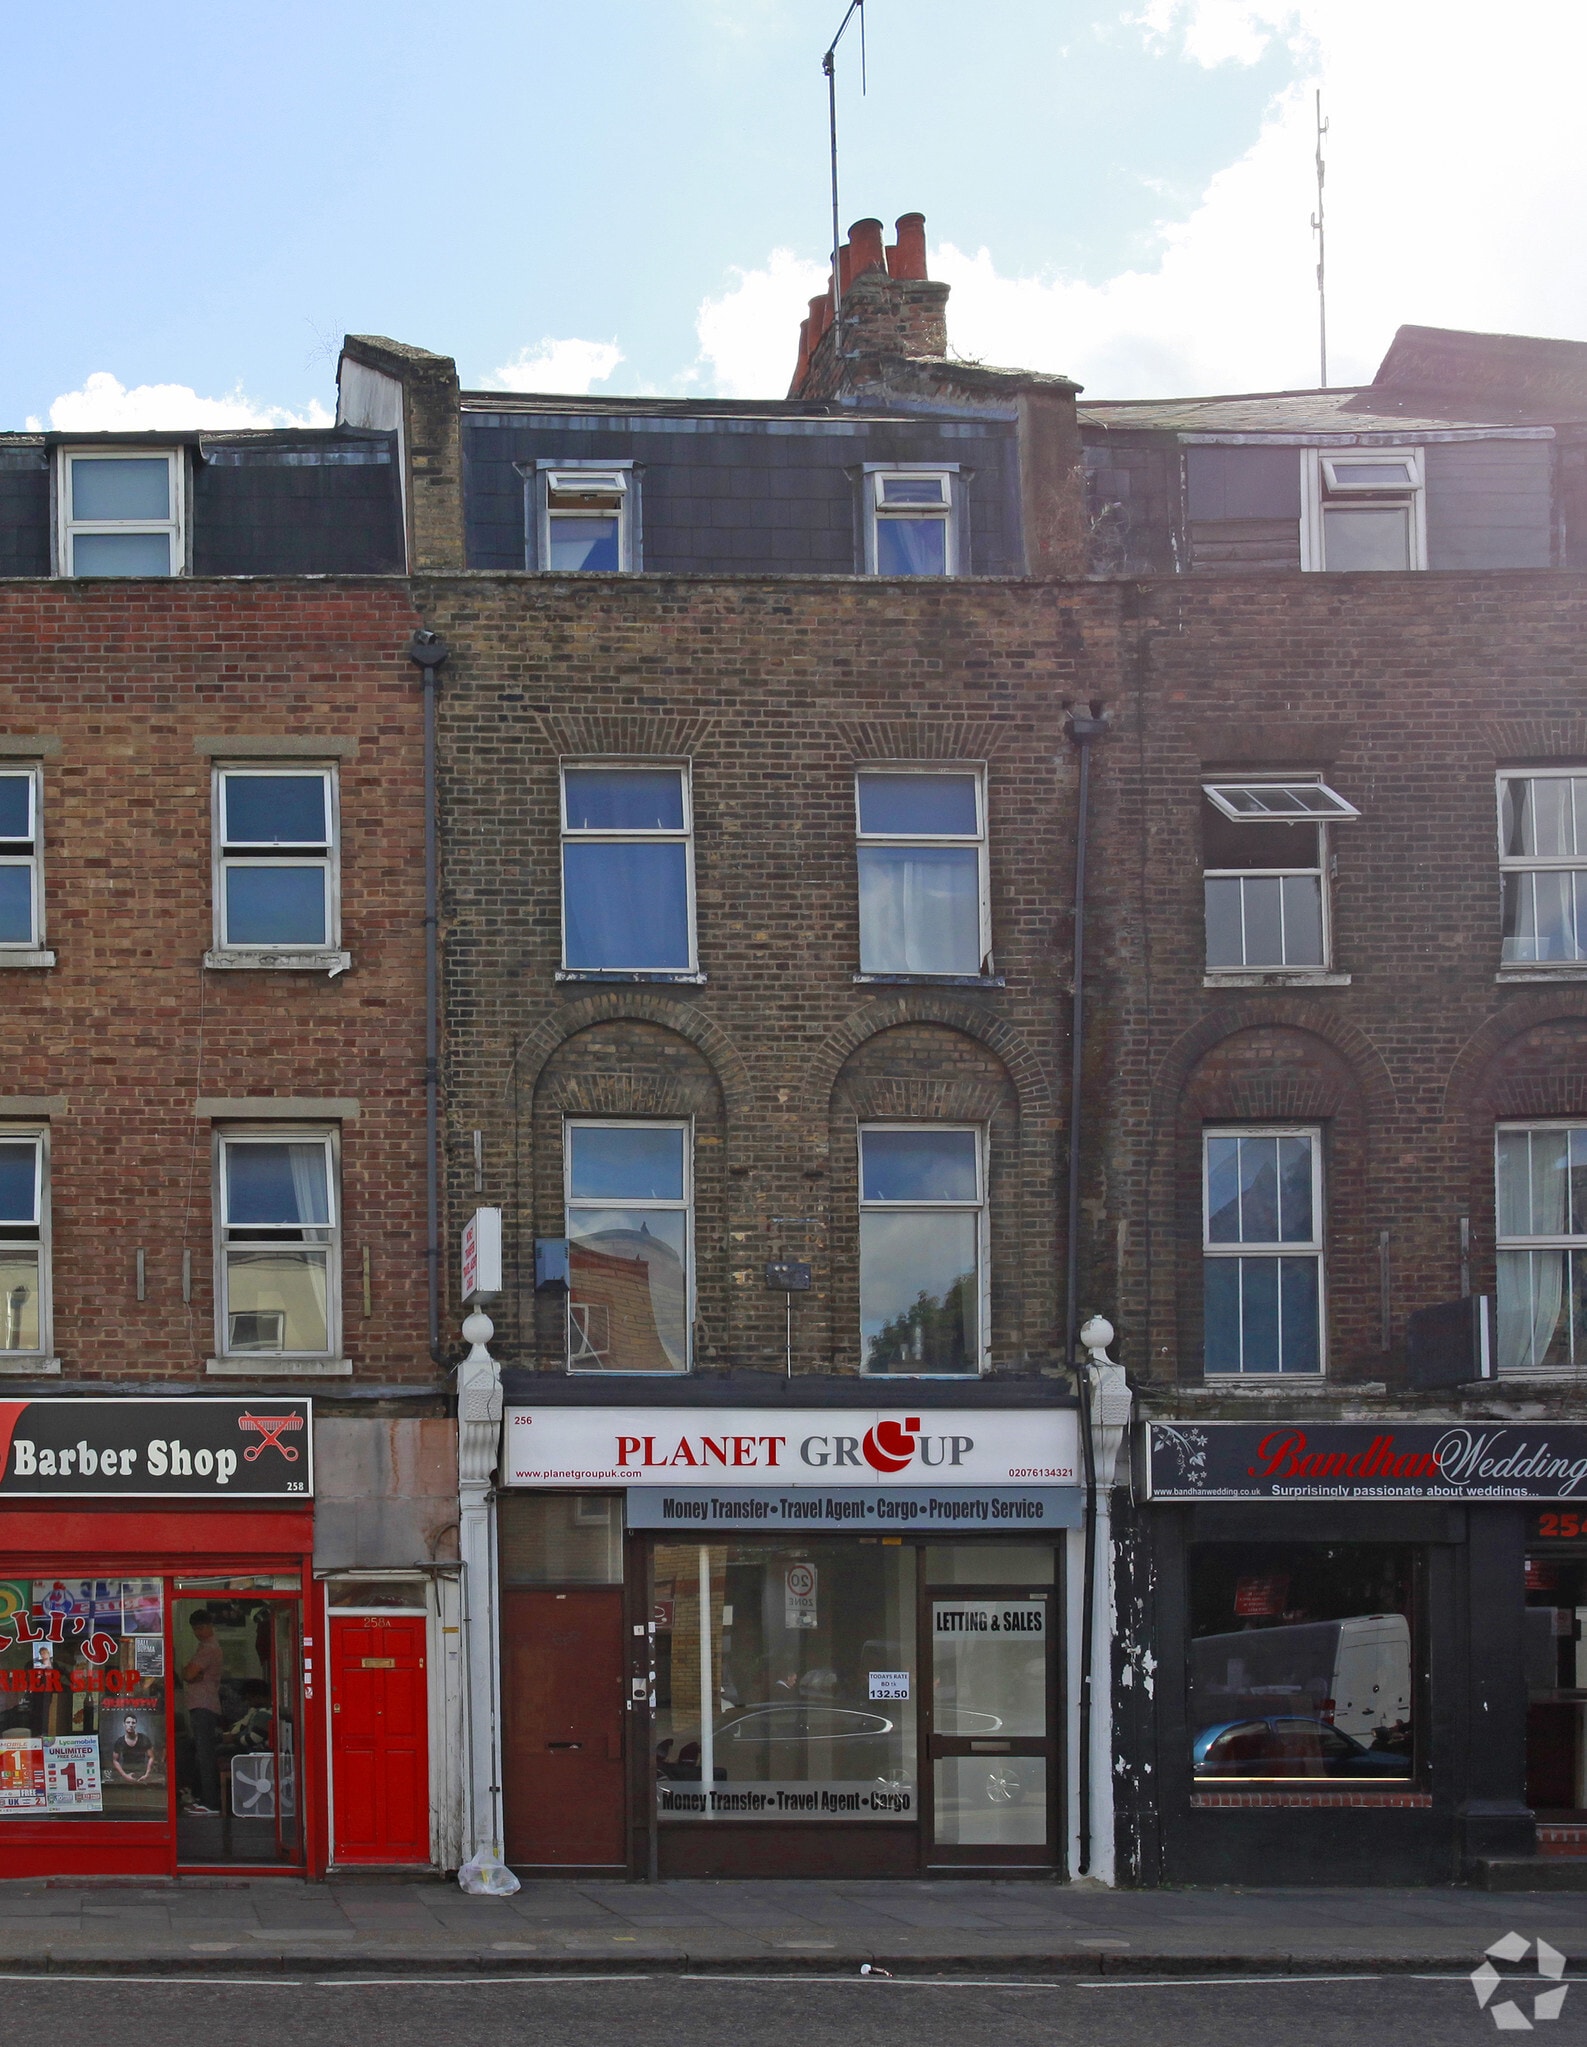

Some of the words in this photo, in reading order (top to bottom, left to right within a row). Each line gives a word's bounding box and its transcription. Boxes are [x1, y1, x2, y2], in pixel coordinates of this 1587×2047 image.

[514, 1416, 533, 1425] 256
[615, 1436, 786, 1467] PLANET
[1248, 1428, 1442, 1478] Bandhan
[14, 1440, 137, 1476] Barber
[147, 1440, 237, 1484] Shop
[515, 1469, 642, 1480] www.planetgroupuk.com
[1008, 1468, 1074, 1477] 02076134321
[287, 1481, 305, 1491] 258
[1153, 1487, 1261, 1497] www.bandhanwedding.co.uk
[1271, 1484, 1350, 1497] Surprisingly
[1353, 1485, 1423, 1497] passionate
[1426, 1485, 1464, 1497] about
[663, 1499, 709, 1520] Money
[711, 1499, 768, 1519] Transfer
[781, 1498, 822, 1519] Travel
[825, 1499, 866, 1521] Agent
[877, 1499, 918, 1521] Cargo
[929, 1499, 989, 1521] Property
[991, 1499, 1044, 1519] Service
[936, 1611, 987, 1631] LETTING
[990, 1615, 1000, 1631] &
[1003, 1611, 1042, 1631] SALES
[0, 1610, 119, 1665] LI'S
[70, 1669, 141, 1693] SHOP
[870, 1690, 908, 1698] 132.50
[49, 1747, 93, 1755] UNLIMITED
[662, 1790, 706, 1811] Money
[709, 1790, 767, 1811] Transfer
[777, 1790, 819, 1811] Travel
[821, 1790, 861, 1812] Agent
[870, 1790, 911, 1812] Cargo
